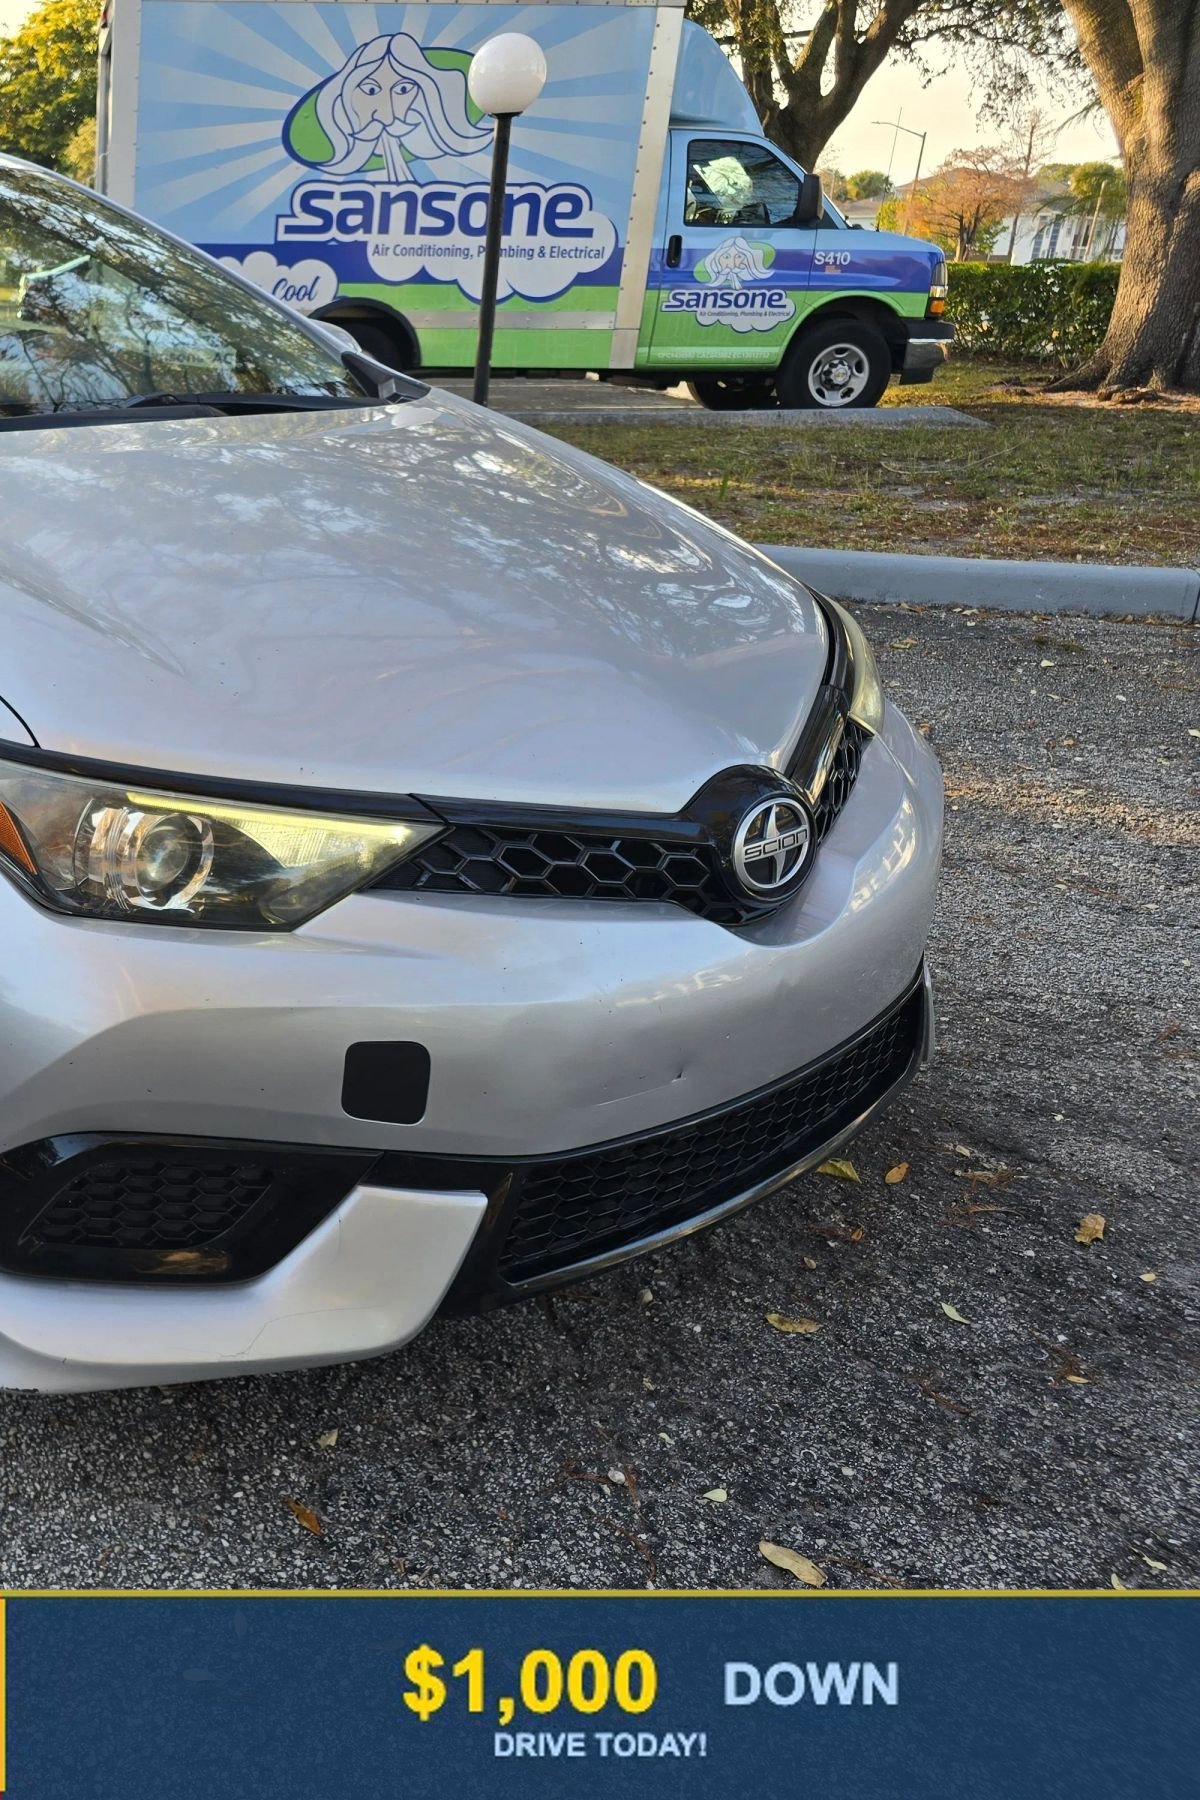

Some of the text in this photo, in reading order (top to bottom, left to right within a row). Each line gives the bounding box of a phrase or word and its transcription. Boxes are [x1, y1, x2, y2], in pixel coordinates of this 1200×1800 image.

[284, 189, 594, 238] sansone
[372, 244, 605, 260] Air Conditioning, Pmbing & Electrical
[815, 251, 850, 265] S410
[272, 275, 320, 301] Cool
[664, 291, 787, 309] sansone
[744, 828, 808, 861] SCION
